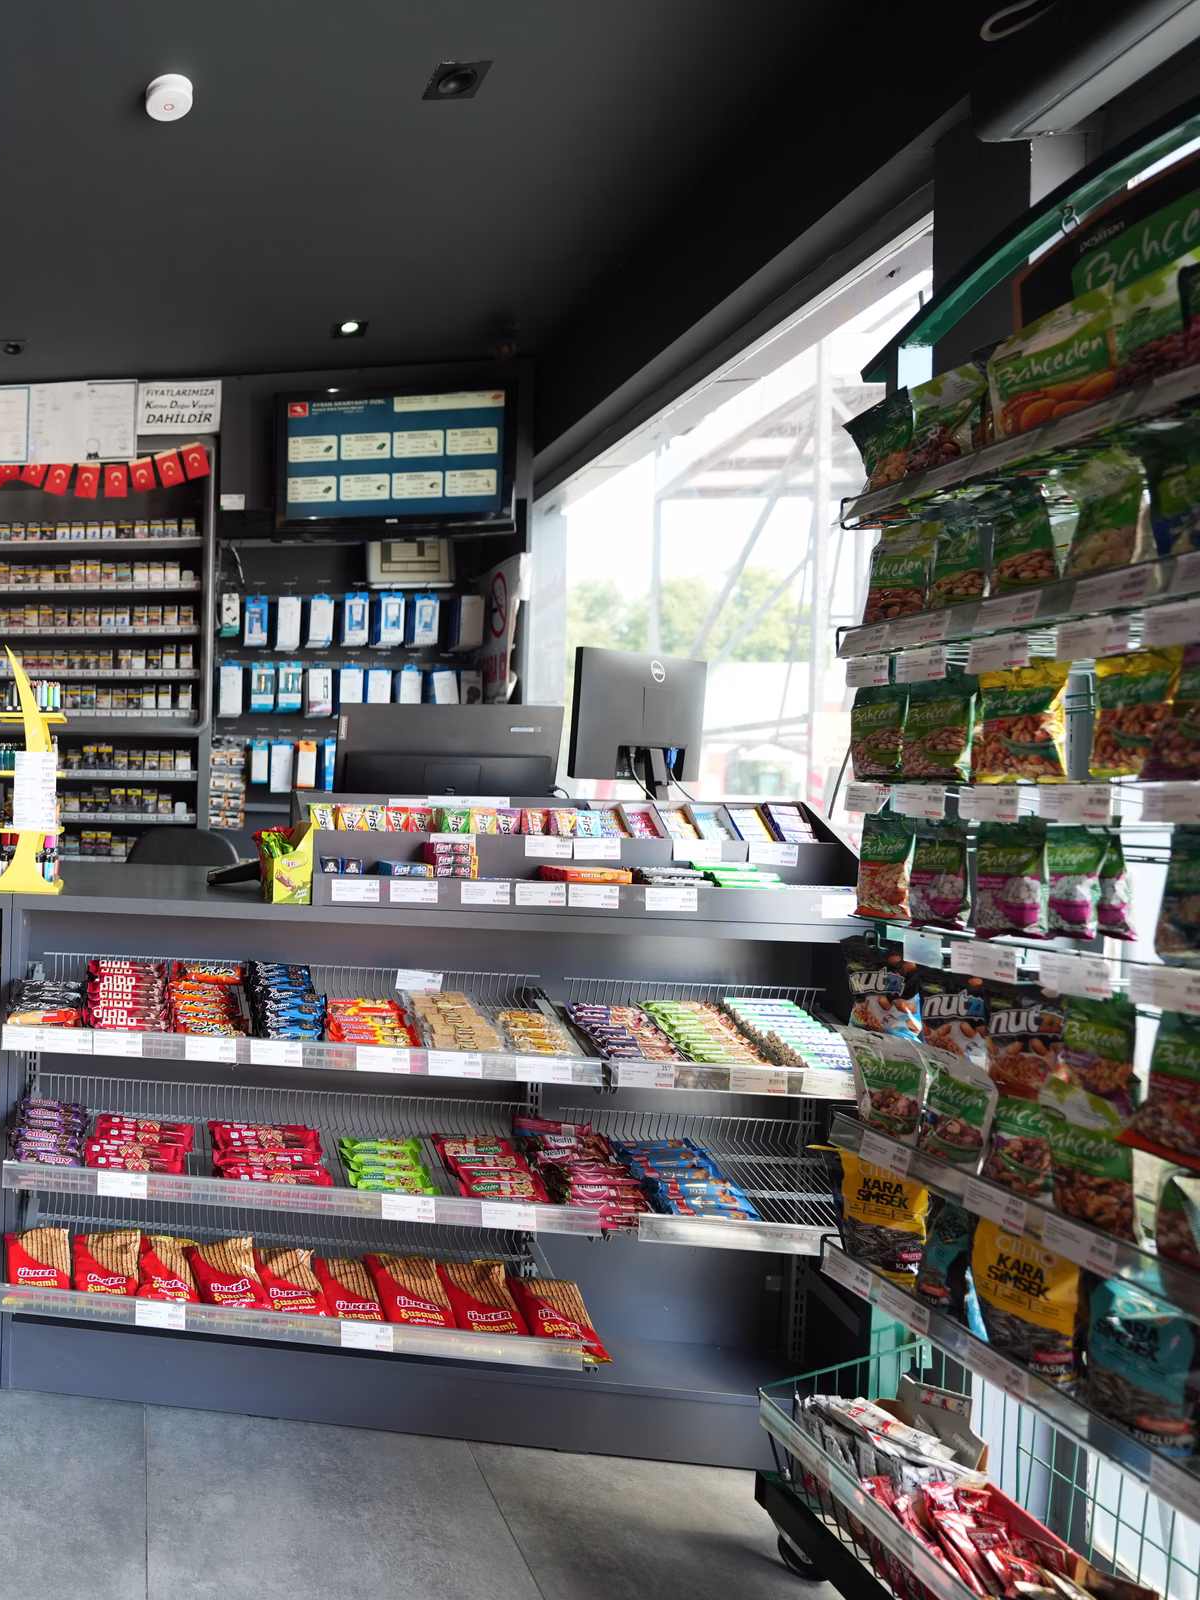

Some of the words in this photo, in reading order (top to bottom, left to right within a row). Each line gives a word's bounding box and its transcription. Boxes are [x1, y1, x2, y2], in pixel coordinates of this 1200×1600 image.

[994, 333, 1104, 386] Bahçeden
[146, 410, 213, 424] DAHİLDİR
[339, 716, 347, 739] Lenovo
[394, 865, 410, 873] First
[549, 1136, 573, 1144] Nesfit
[543, 1149, 567, 1157] Nesfit
[861, 1177, 906, 1198] KARA
[17, 1267, 57, 1278] ÜLKER
[996, 1253, 1045, 1284] KARA
[211, 1278, 251, 1293] ÜLKER
[273, 1297, 316, 1309] Susamlı
[335, 1299, 380, 1311] ÜLKER
[396, 1295, 440, 1312] ÜLKER
[400, 1309, 445, 1321] Susamlı
[467, 1310, 513, 1322] ÜLKER
[472, 1321, 517, 1333] Susamlı
